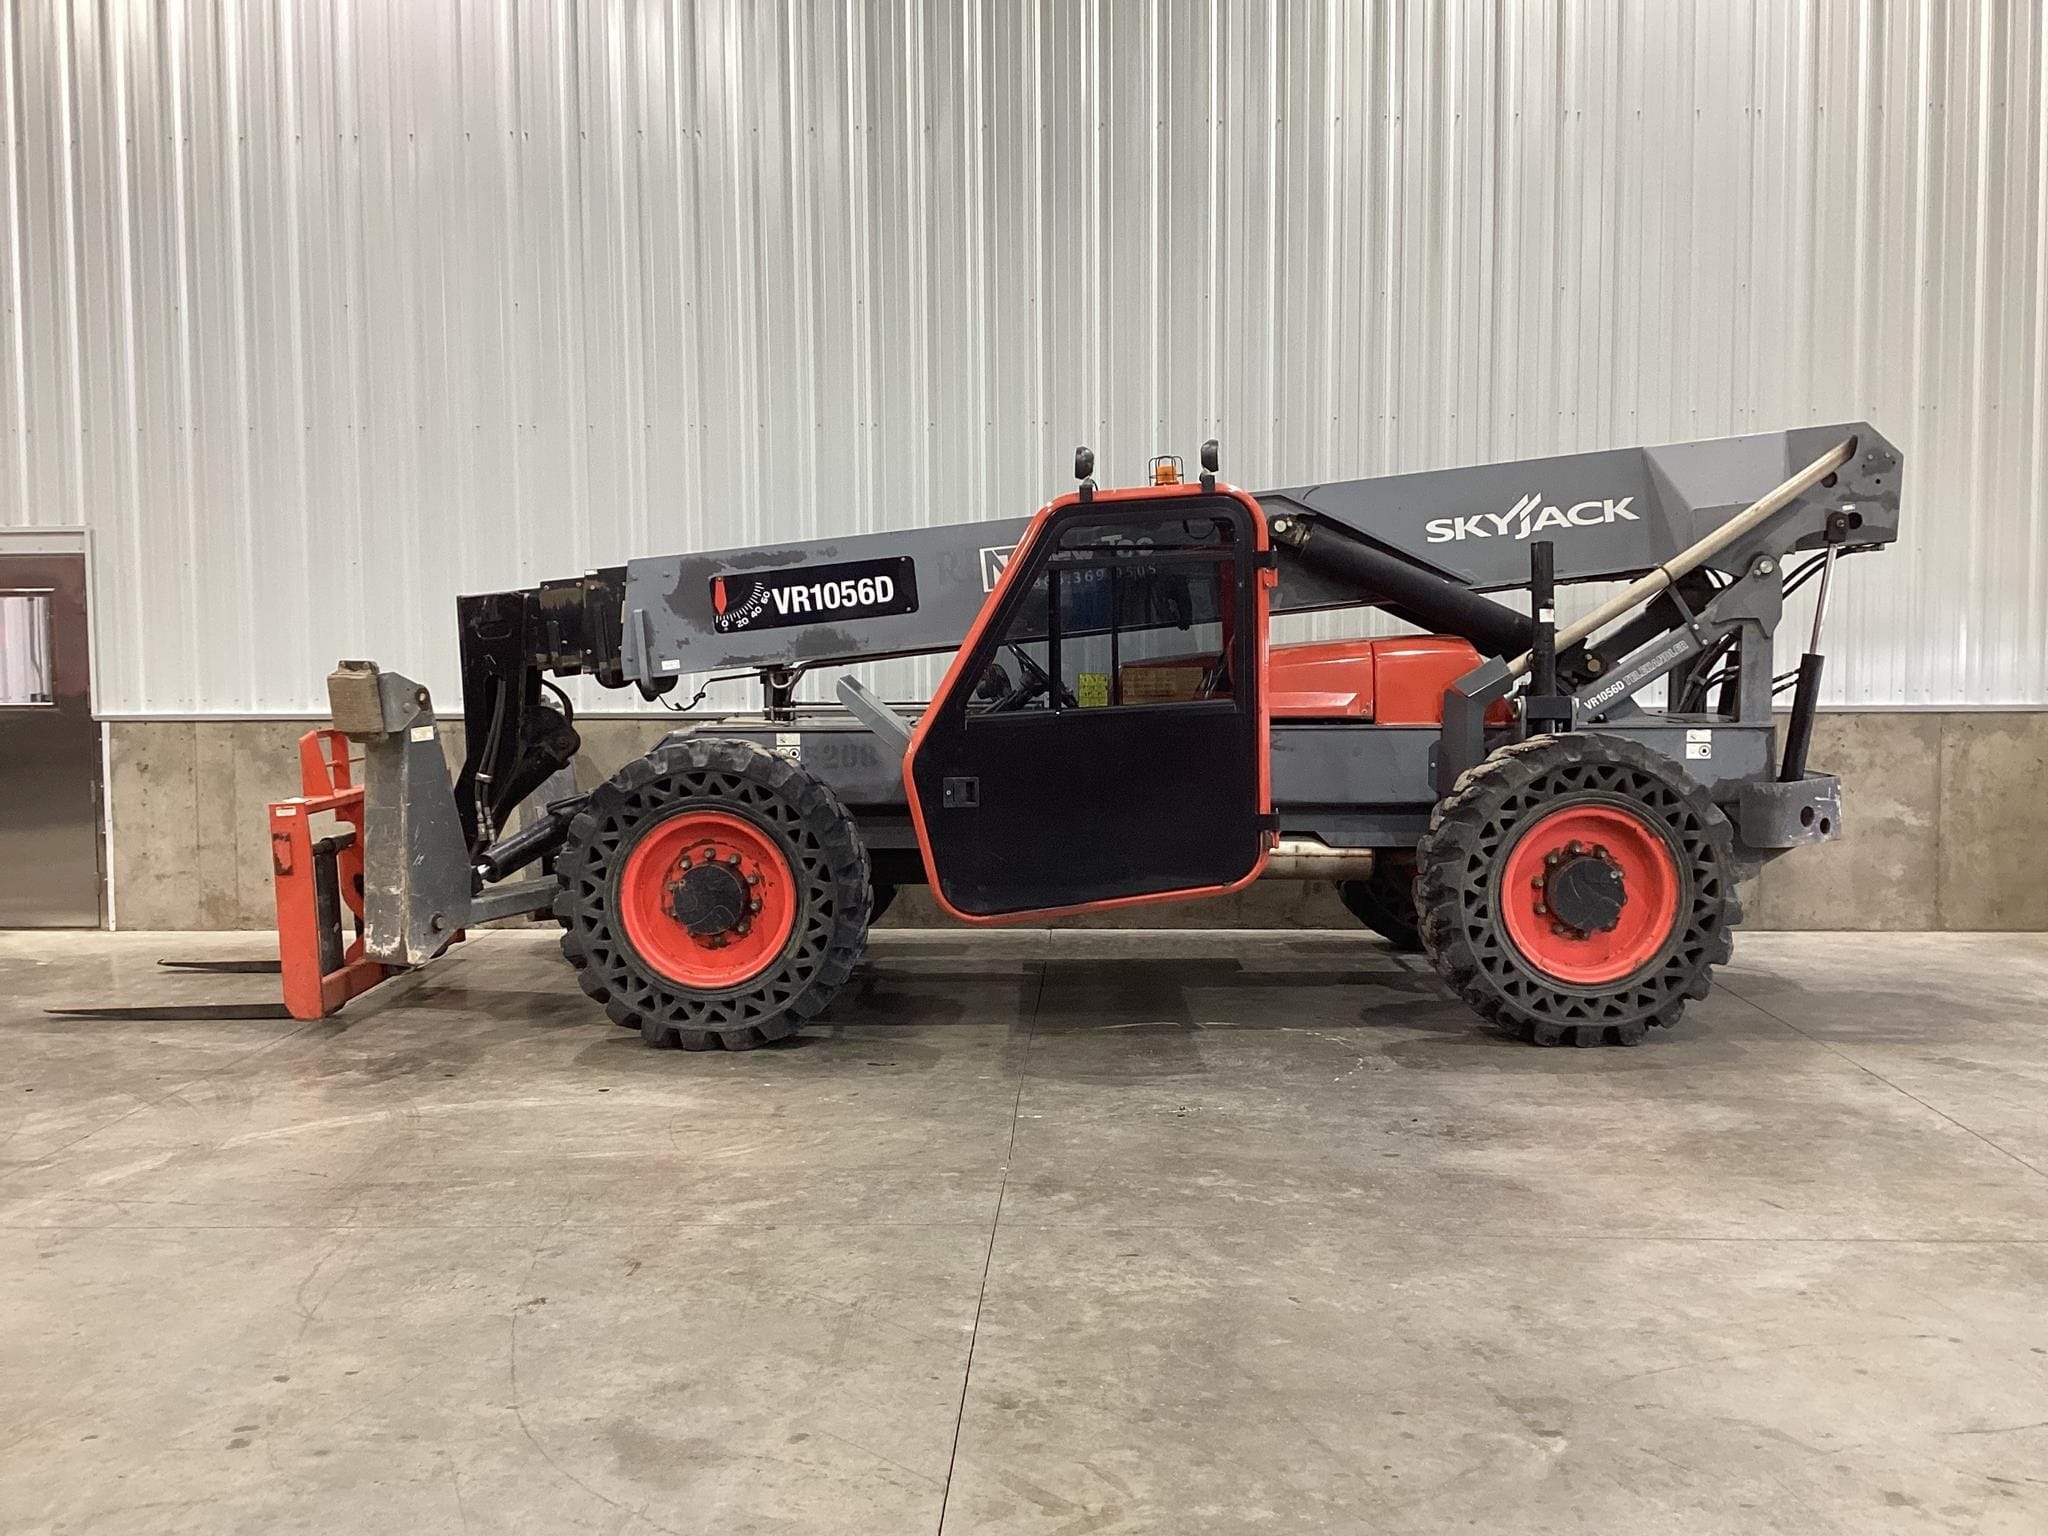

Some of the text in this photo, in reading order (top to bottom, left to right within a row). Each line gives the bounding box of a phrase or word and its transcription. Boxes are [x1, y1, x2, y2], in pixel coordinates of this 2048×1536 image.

[1425, 492, 1641, 543] SKYJACK
[760, 590, 771, 605] 60
[771, 575, 894, 615] VR1056D
[750, 606, 763, 619] 40
[721, 619, 729, 628] 0
[735, 618, 749, 628] 20
[1583, 681, 1625, 711] VR1056D
